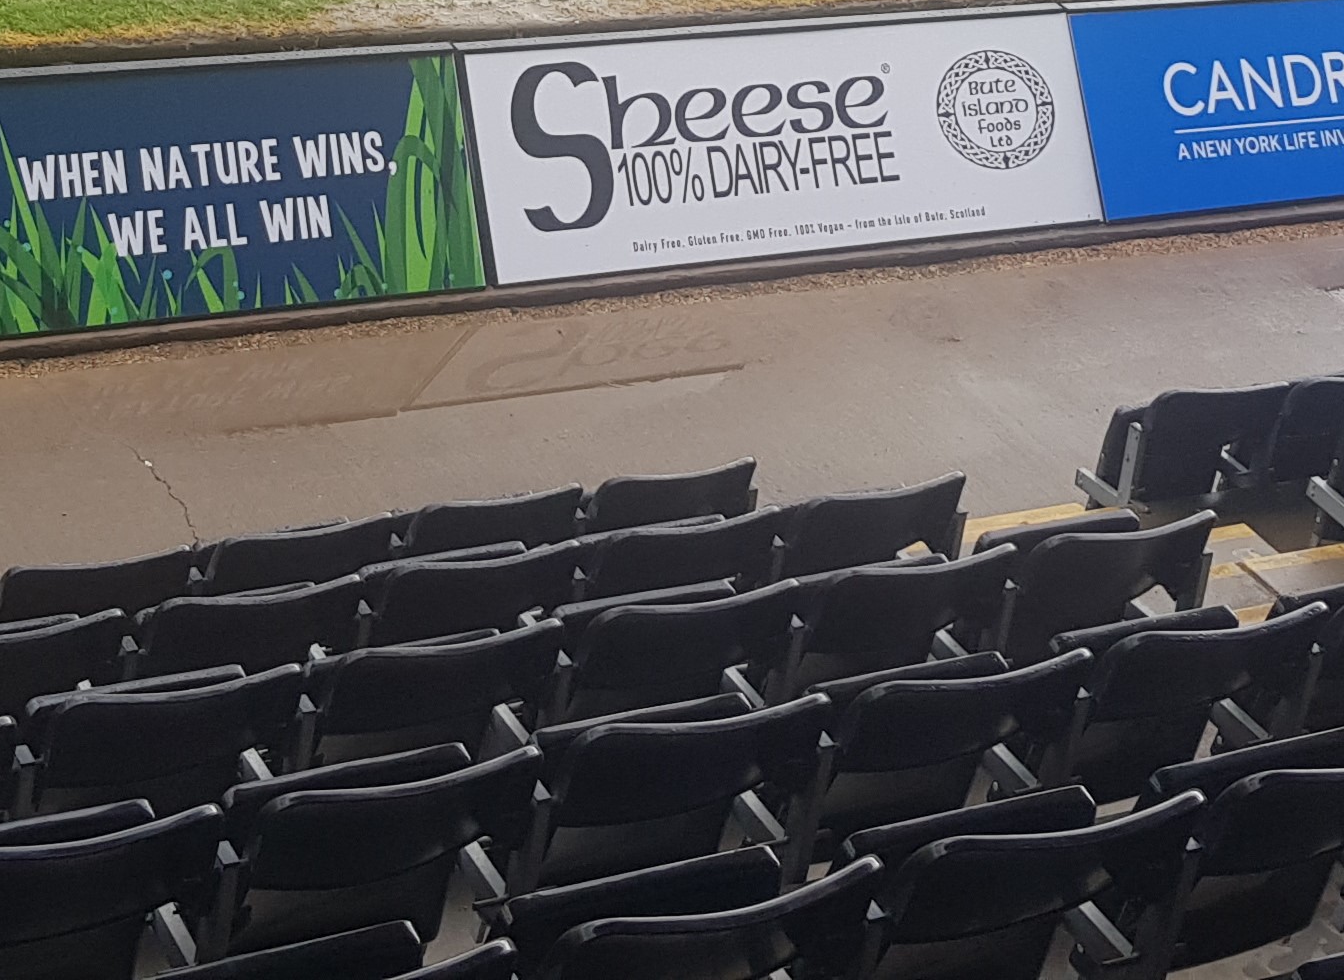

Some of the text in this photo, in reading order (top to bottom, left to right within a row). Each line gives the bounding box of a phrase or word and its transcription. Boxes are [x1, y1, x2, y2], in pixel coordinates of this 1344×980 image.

[968, 77, 1017, 96] Bute
[18, 130, 398, 201] WHEN NATURE WINS,
[617, 131, 901, 207] 100% DAIRY-FREE
[1178, 144, 1191, 161] A
[1192, 139, 1233, 159] NEW
[1234, 134, 1282, 155] YORK
[1283, 130, 1319, 151] LIFE
[107, 194, 333, 257] WE ALL WIN
[633, 240, 657, 253] Dairy
[687, 235, 718, 247] Gluten
[746, 228, 766, 241] GMO
[795, 224, 815, 235] 100%
[818, 222, 844, 235] Vegan
[855, 219, 876, 230] from
[878, 216, 892, 227] the
[914, 212, 922, 224] of
[949, 206, 986, 220] Scotland
